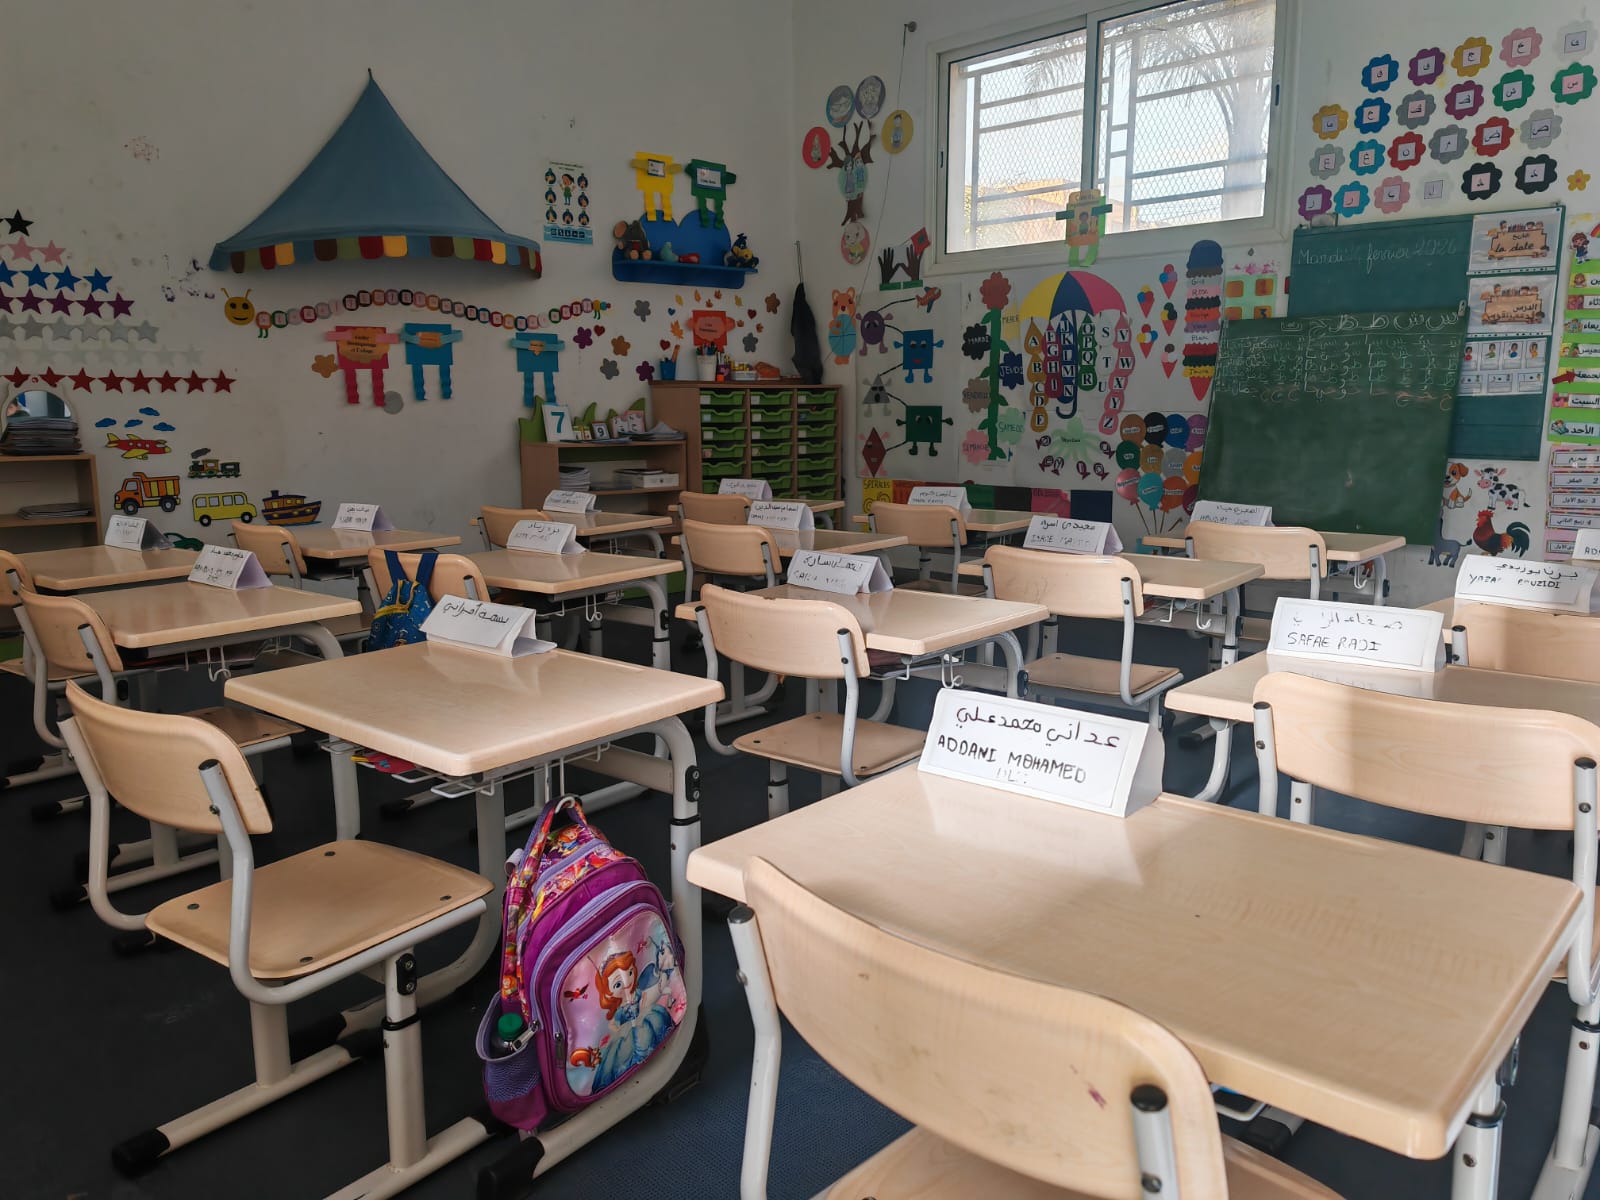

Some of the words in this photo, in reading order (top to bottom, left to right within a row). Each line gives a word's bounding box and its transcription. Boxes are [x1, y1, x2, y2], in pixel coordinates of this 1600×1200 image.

[1510, 242, 1534, 252] date
[551, 412, 565, 434] 7
[1570, 423, 1594, 434] الأحد
[1469, 574, 1502, 585] YAZA
[1287, 631, 1331, 648] SAFAE
[957, 706, 997, 729] علي
[1000, 717, 1042, 733] محمد
[1046, 721, 1120, 748] عداني
[937, 734, 997, 763] ADDANI
[1008, 751, 1087, 784] MOHAMED
